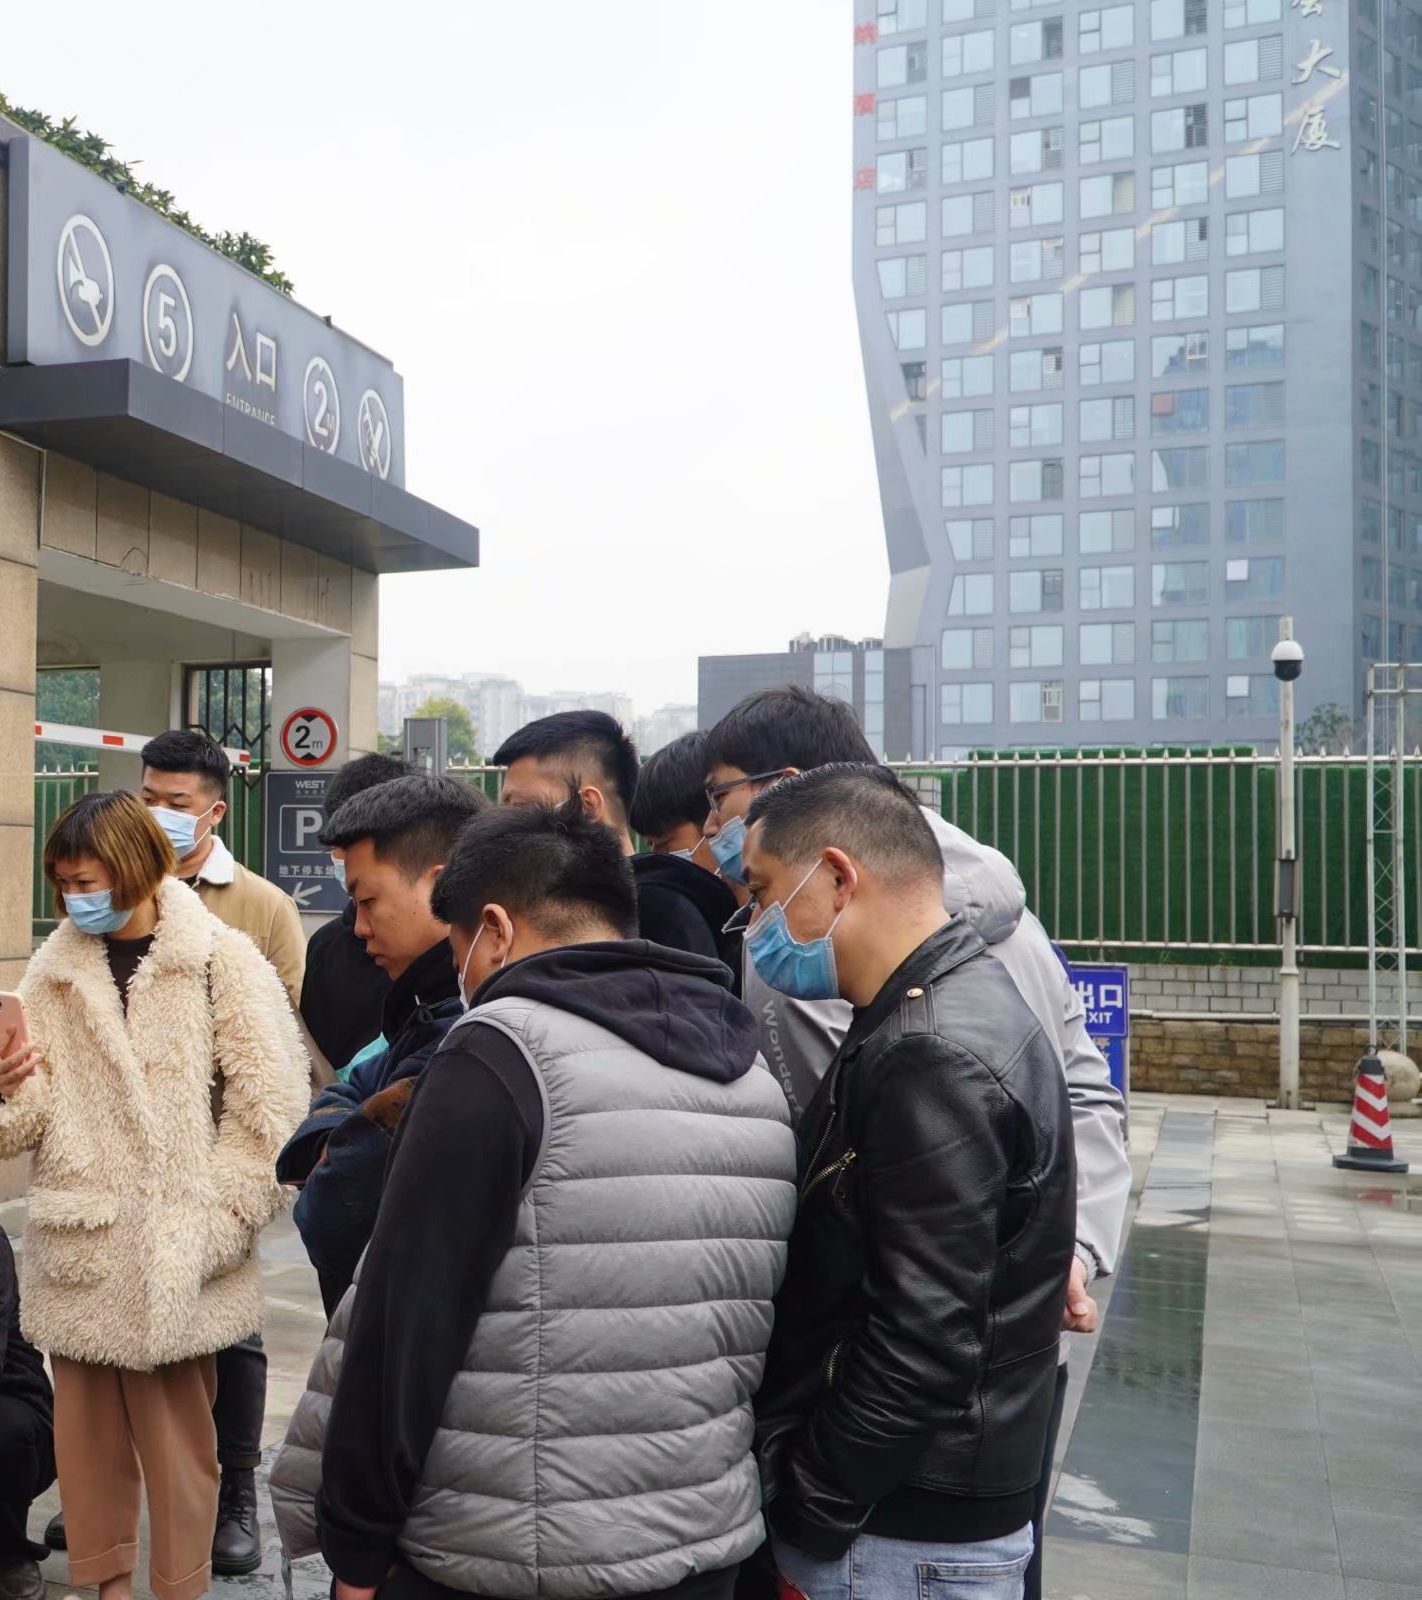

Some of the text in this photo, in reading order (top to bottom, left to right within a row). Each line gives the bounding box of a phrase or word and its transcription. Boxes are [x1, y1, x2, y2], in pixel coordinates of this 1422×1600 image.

[158, 291, 178, 358] 5
[226, 312, 276, 393] 入口
[295, 780, 325, 789] WEST
[296, 810, 323, 847] P
[1088, 1011, 1113, 1024] XIT
